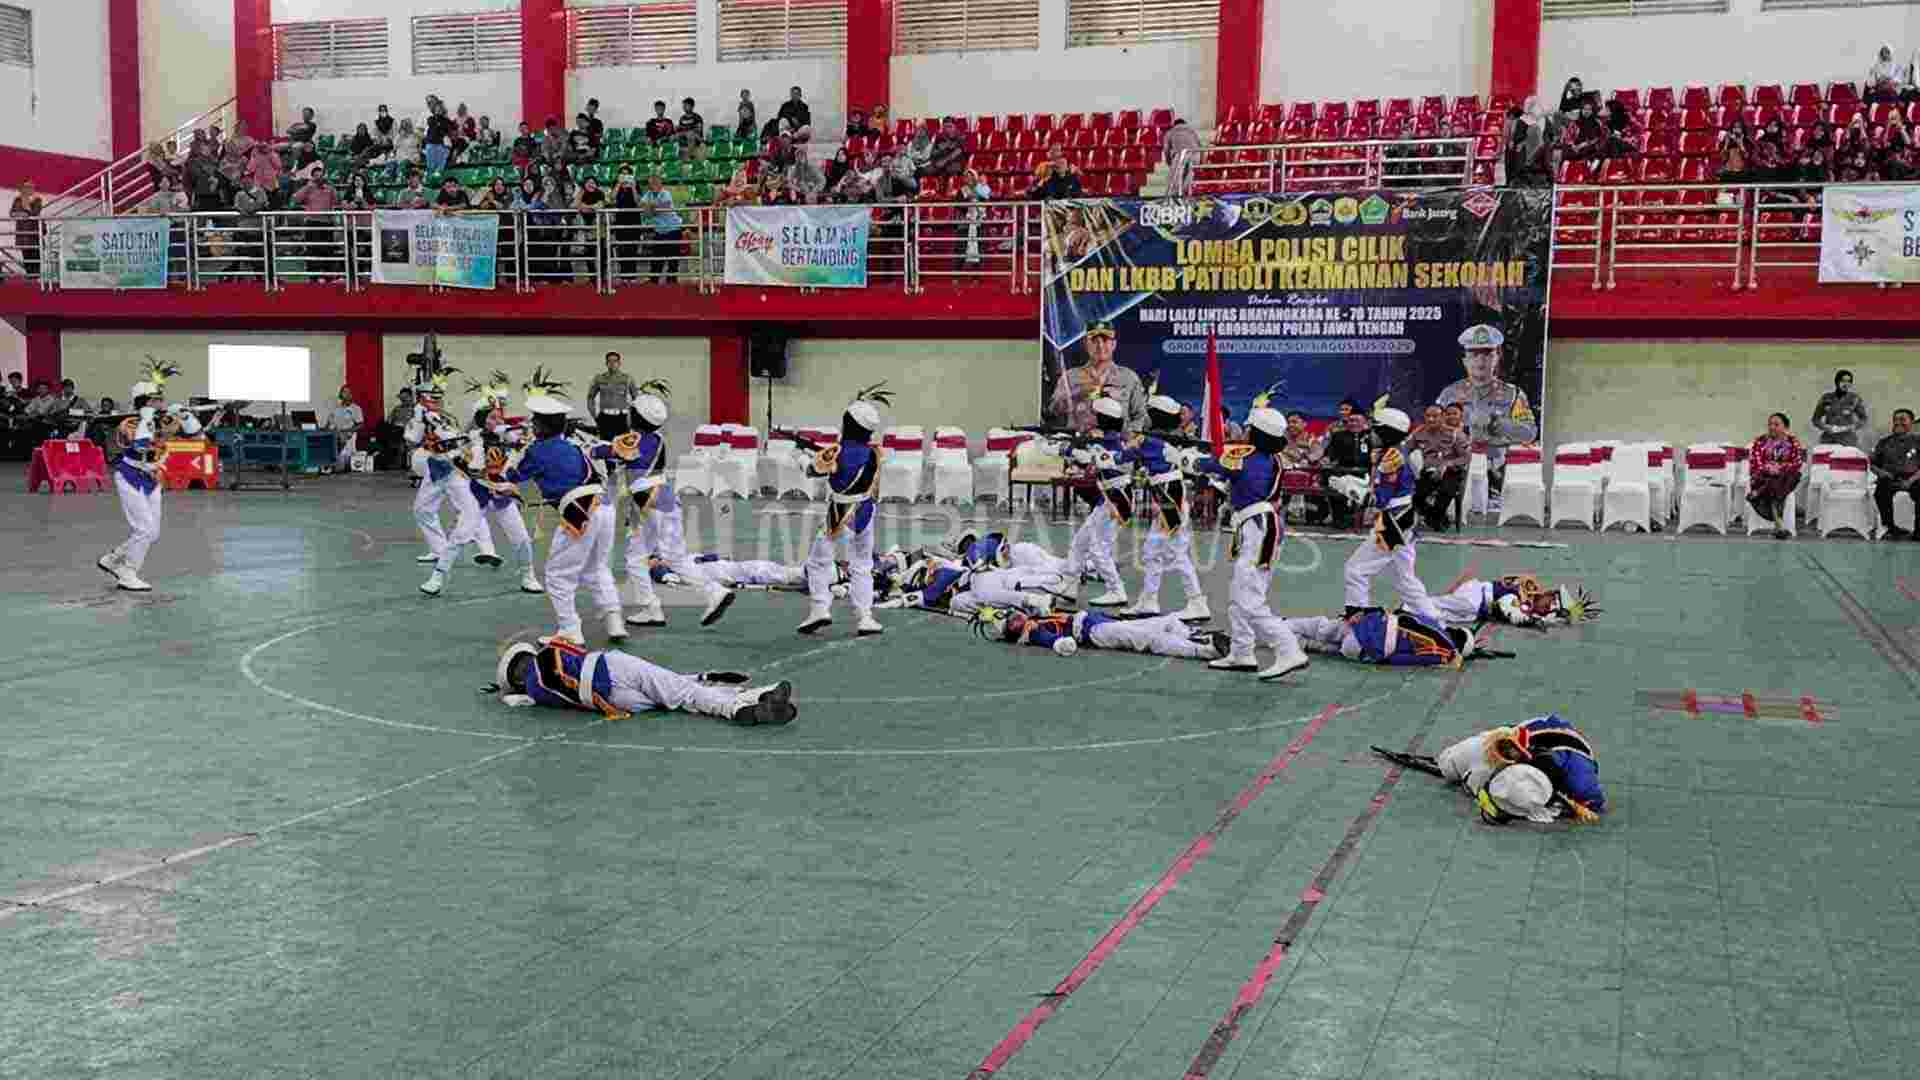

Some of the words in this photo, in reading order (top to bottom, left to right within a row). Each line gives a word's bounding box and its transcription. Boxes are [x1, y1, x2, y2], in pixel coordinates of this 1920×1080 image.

[101, 231, 134, 250] SATU
[136, 231, 160, 250] TIM
[782, 227, 858, 244] SELAMAT
[782, 247, 857, 266] BERTANDING
[1176, 239, 1254, 265] LOMBA
[1260, 238, 1335, 264] POLISI
[1342, 236, 1405, 262] CILIK
[1071, 267, 1114, 292] DAN
[1119, 266, 1176, 292] LKBB
[1183, 265, 1273, 291] PATROLI
[1279, 263, 1408, 290] KEAMANAN
[1415, 261, 1525, 288] SEKOLAH
[1139, 308, 1167, 322] HARI
[1169, 308, 1196, 322] LALU
[1198, 308, 1238, 321] LINTAS
[1239, 307, 1323, 321] BHAYANGKARA
[1325, 307, 1340, 321] KE
[1350, 307, 1365, 321] 70
[1368, 307, 1407, 320] TAHUN
[1409, 306, 1442, 320] 2025
[1217, 322, 1281, 335] GROBOGAN
[1283, 322, 1321, 335] POLDA
[1322, 321, 1355, 335] JAWA
[1357, 321, 1405, 335] TENGAH
